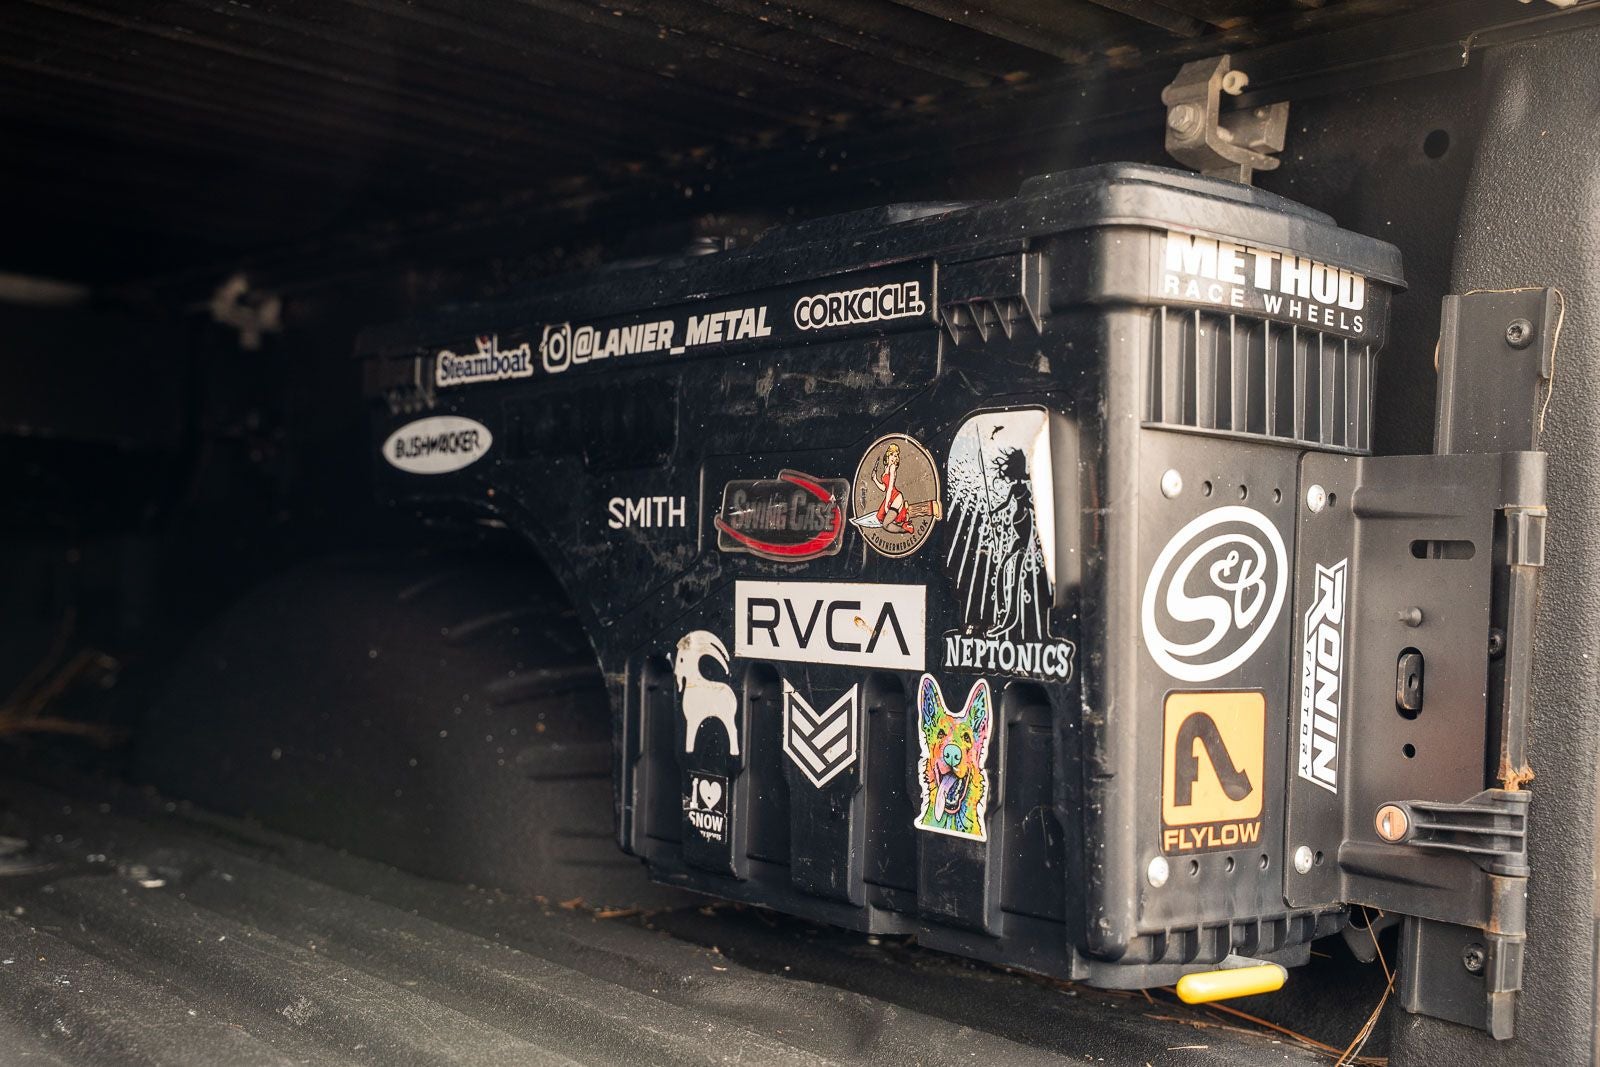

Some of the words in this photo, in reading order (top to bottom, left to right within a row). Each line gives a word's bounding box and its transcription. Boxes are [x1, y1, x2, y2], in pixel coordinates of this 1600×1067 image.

[1164, 274, 1244, 307] RACE
[1165, 231, 1365, 311] METHOD
[1263, 293, 1364, 333] WHEELS
[572, 306, 772, 364] @LANIER_METAL
[440, 343, 528, 382] Steamboat
[608, 497, 686, 530] SMITH
[747, 597, 912, 656] RVCA
[945, 635, 1071, 678] NEPTONICS
[1308, 568, 1344, 787] RONIN
[1301, 650, 1312, 775] FACTORY
[688, 811, 723, 832] SNOW
[1163, 822, 1261, 851] FLYLOW
